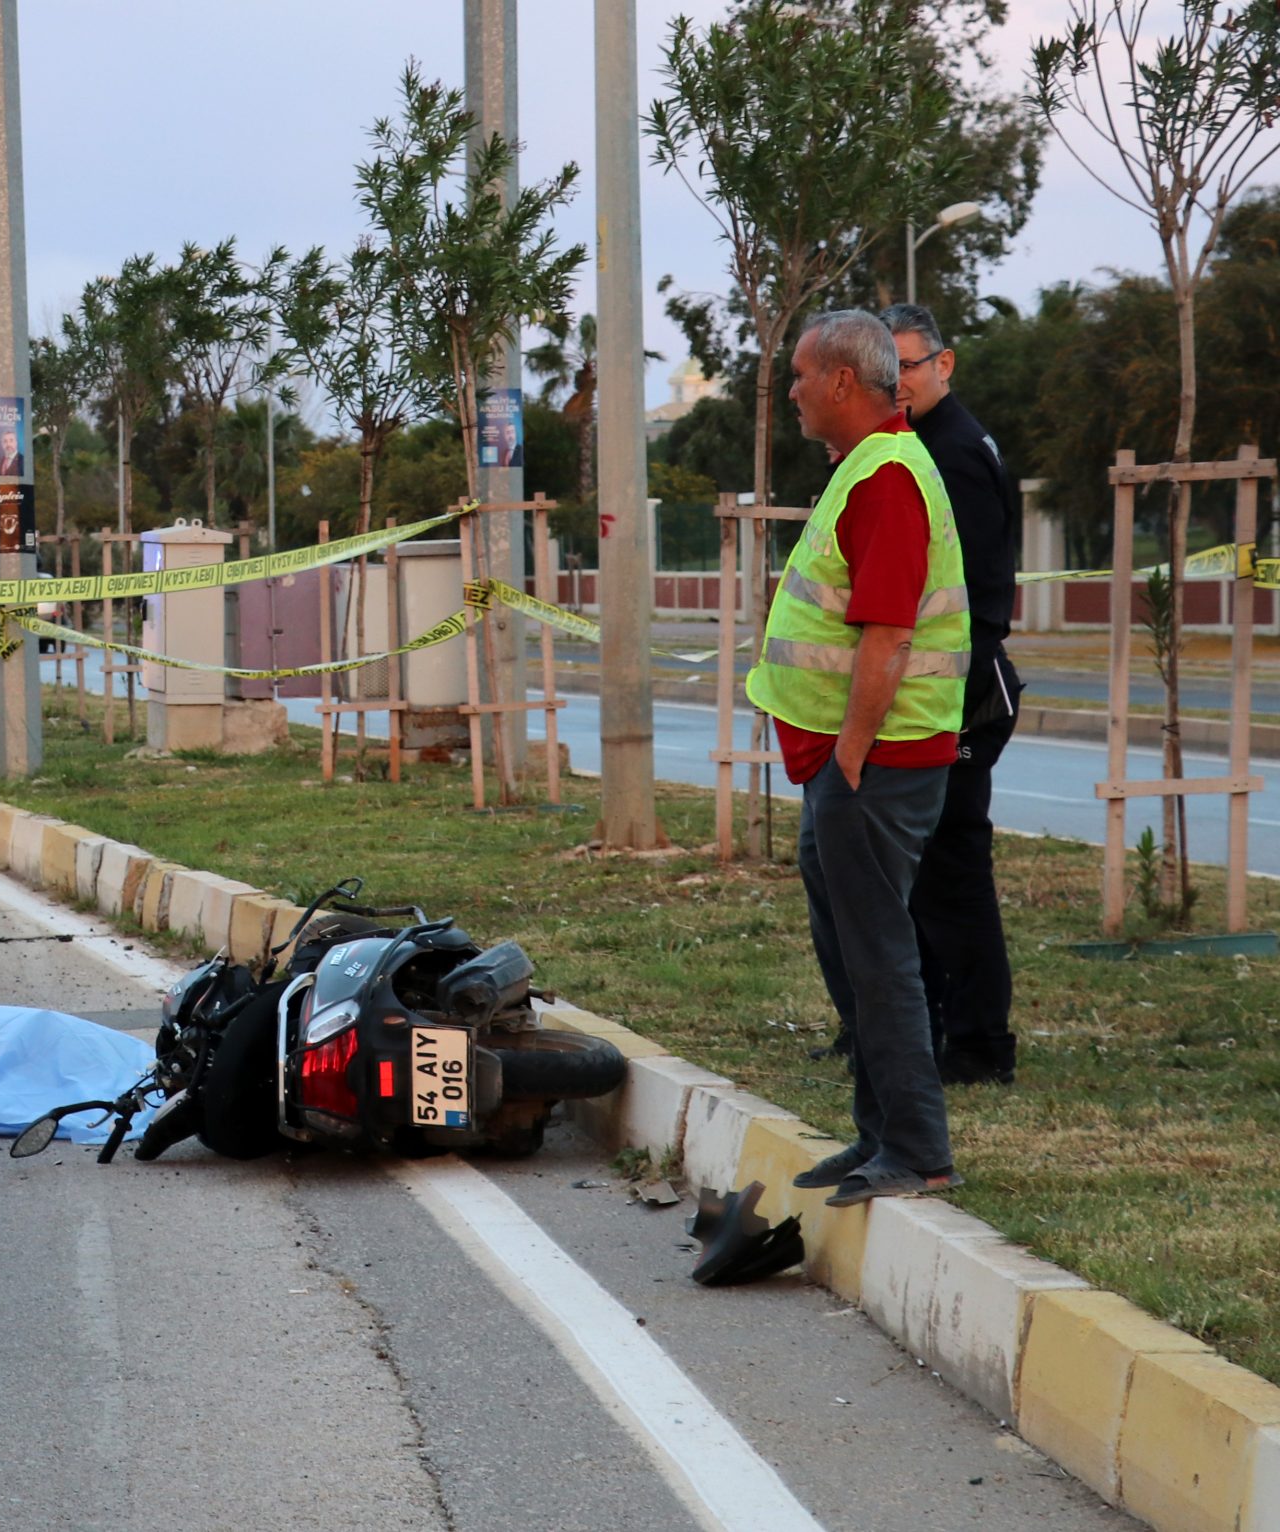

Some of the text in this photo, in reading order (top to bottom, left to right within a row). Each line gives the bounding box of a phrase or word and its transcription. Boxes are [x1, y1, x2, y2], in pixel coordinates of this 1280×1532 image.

[417, 1033, 438, 1121] 54 AIY
[442, 1060, 463, 1099] 016
